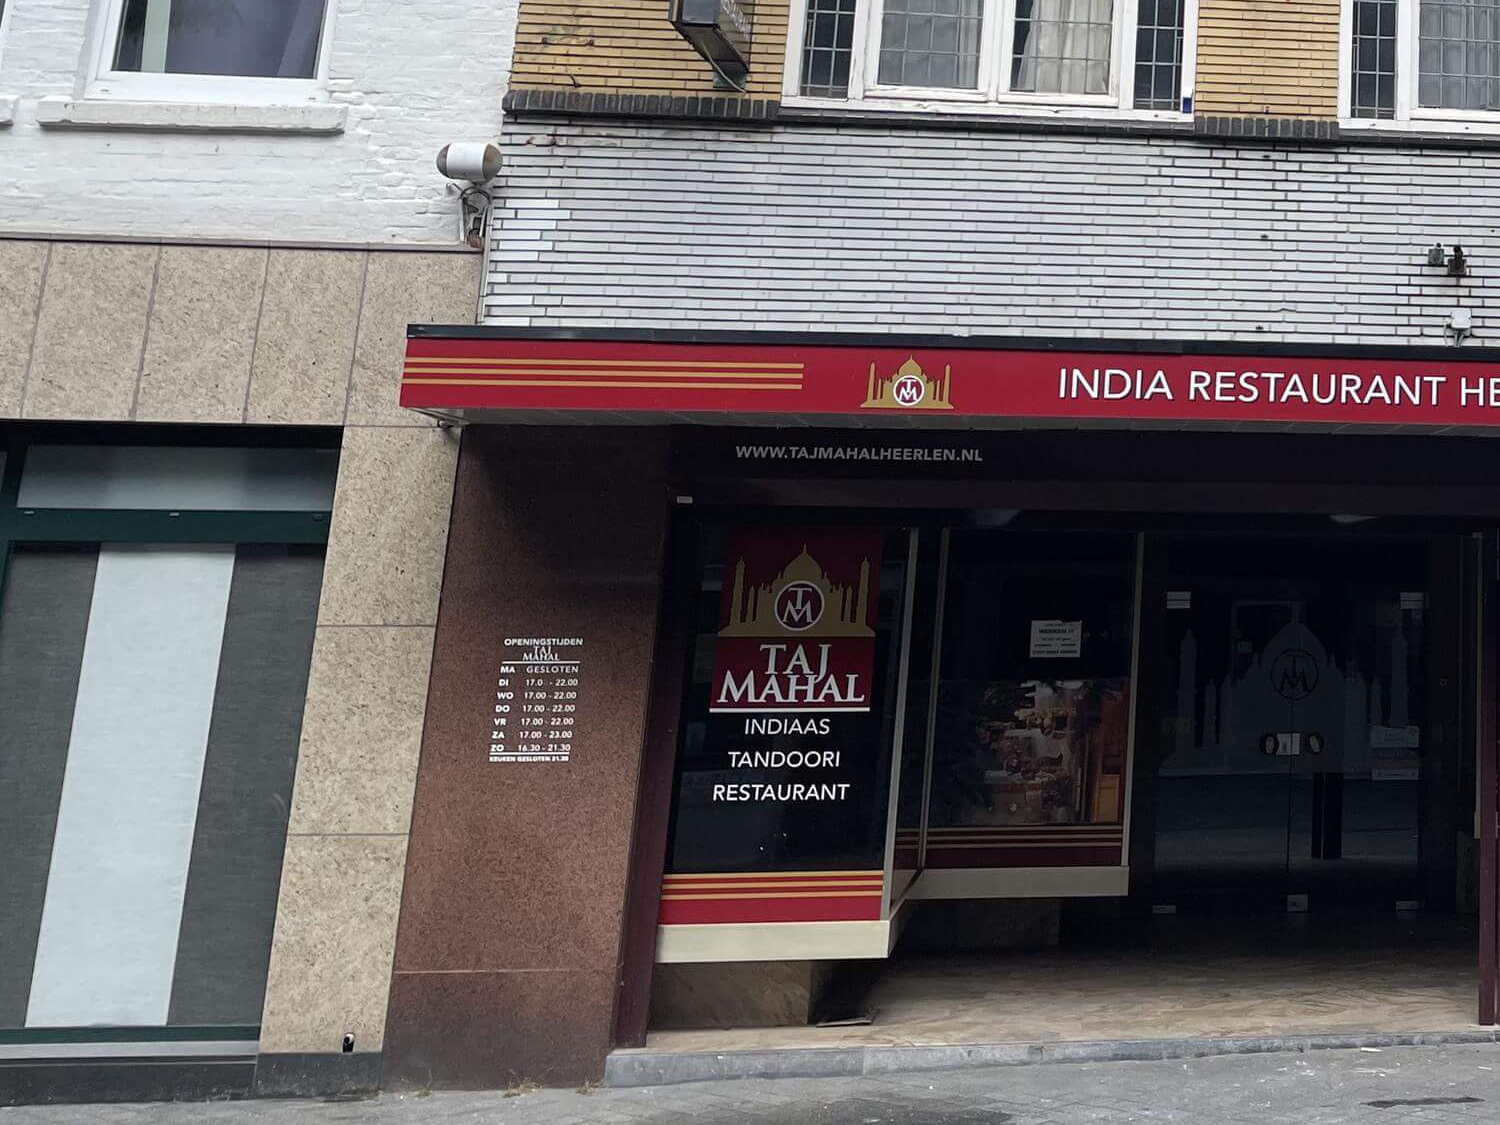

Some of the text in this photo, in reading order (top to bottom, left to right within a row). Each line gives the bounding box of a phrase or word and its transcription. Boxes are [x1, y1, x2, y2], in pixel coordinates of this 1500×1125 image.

[1059, 368, 1175, 401] INDIA
[1188, 371, 1447, 407] RESTAURANT
[735, 445, 984, 462] WWW.TAJMAHALHEERLEN.NL
[504, 638, 584, 646] OPENINGSTIJDEN
[534, 646, 552, 655] TAJ
[522, 653, 560, 661] MAHAL
[759, 643, 833, 684] TAJ
[500, 665, 579, 674] MA GESLOTEN
[498, 679, 509, 687] DI
[555, 678, 579, 687] 22.00
[716, 670, 866, 703] MAHAL
[554, 691, 577, 699] 22.00
[495, 705, 510, 713] DO
[522, 705, 545, 713] 17.00
[552, 704, 576, 712] 22.00
[493, 718, 507, 726] VR
[521, 718, 544, 726] 17.00
[550, 717, 574, 725] 22.00
[744, 718, 831, 735] INDIAAS
[491, 731, 505, 739] ZA
[519, 731, 542, 739] 17.00
[548, 730, 573, 738] 23.00
[490, 744, 505, 752] ZO
[518, 744, 541, 752] 16.30
[547, 743, 571, 752] 21.30
[727, 751, 841, 768] TANDOORI
[712, 783, 851, 802] RESTAURANT
